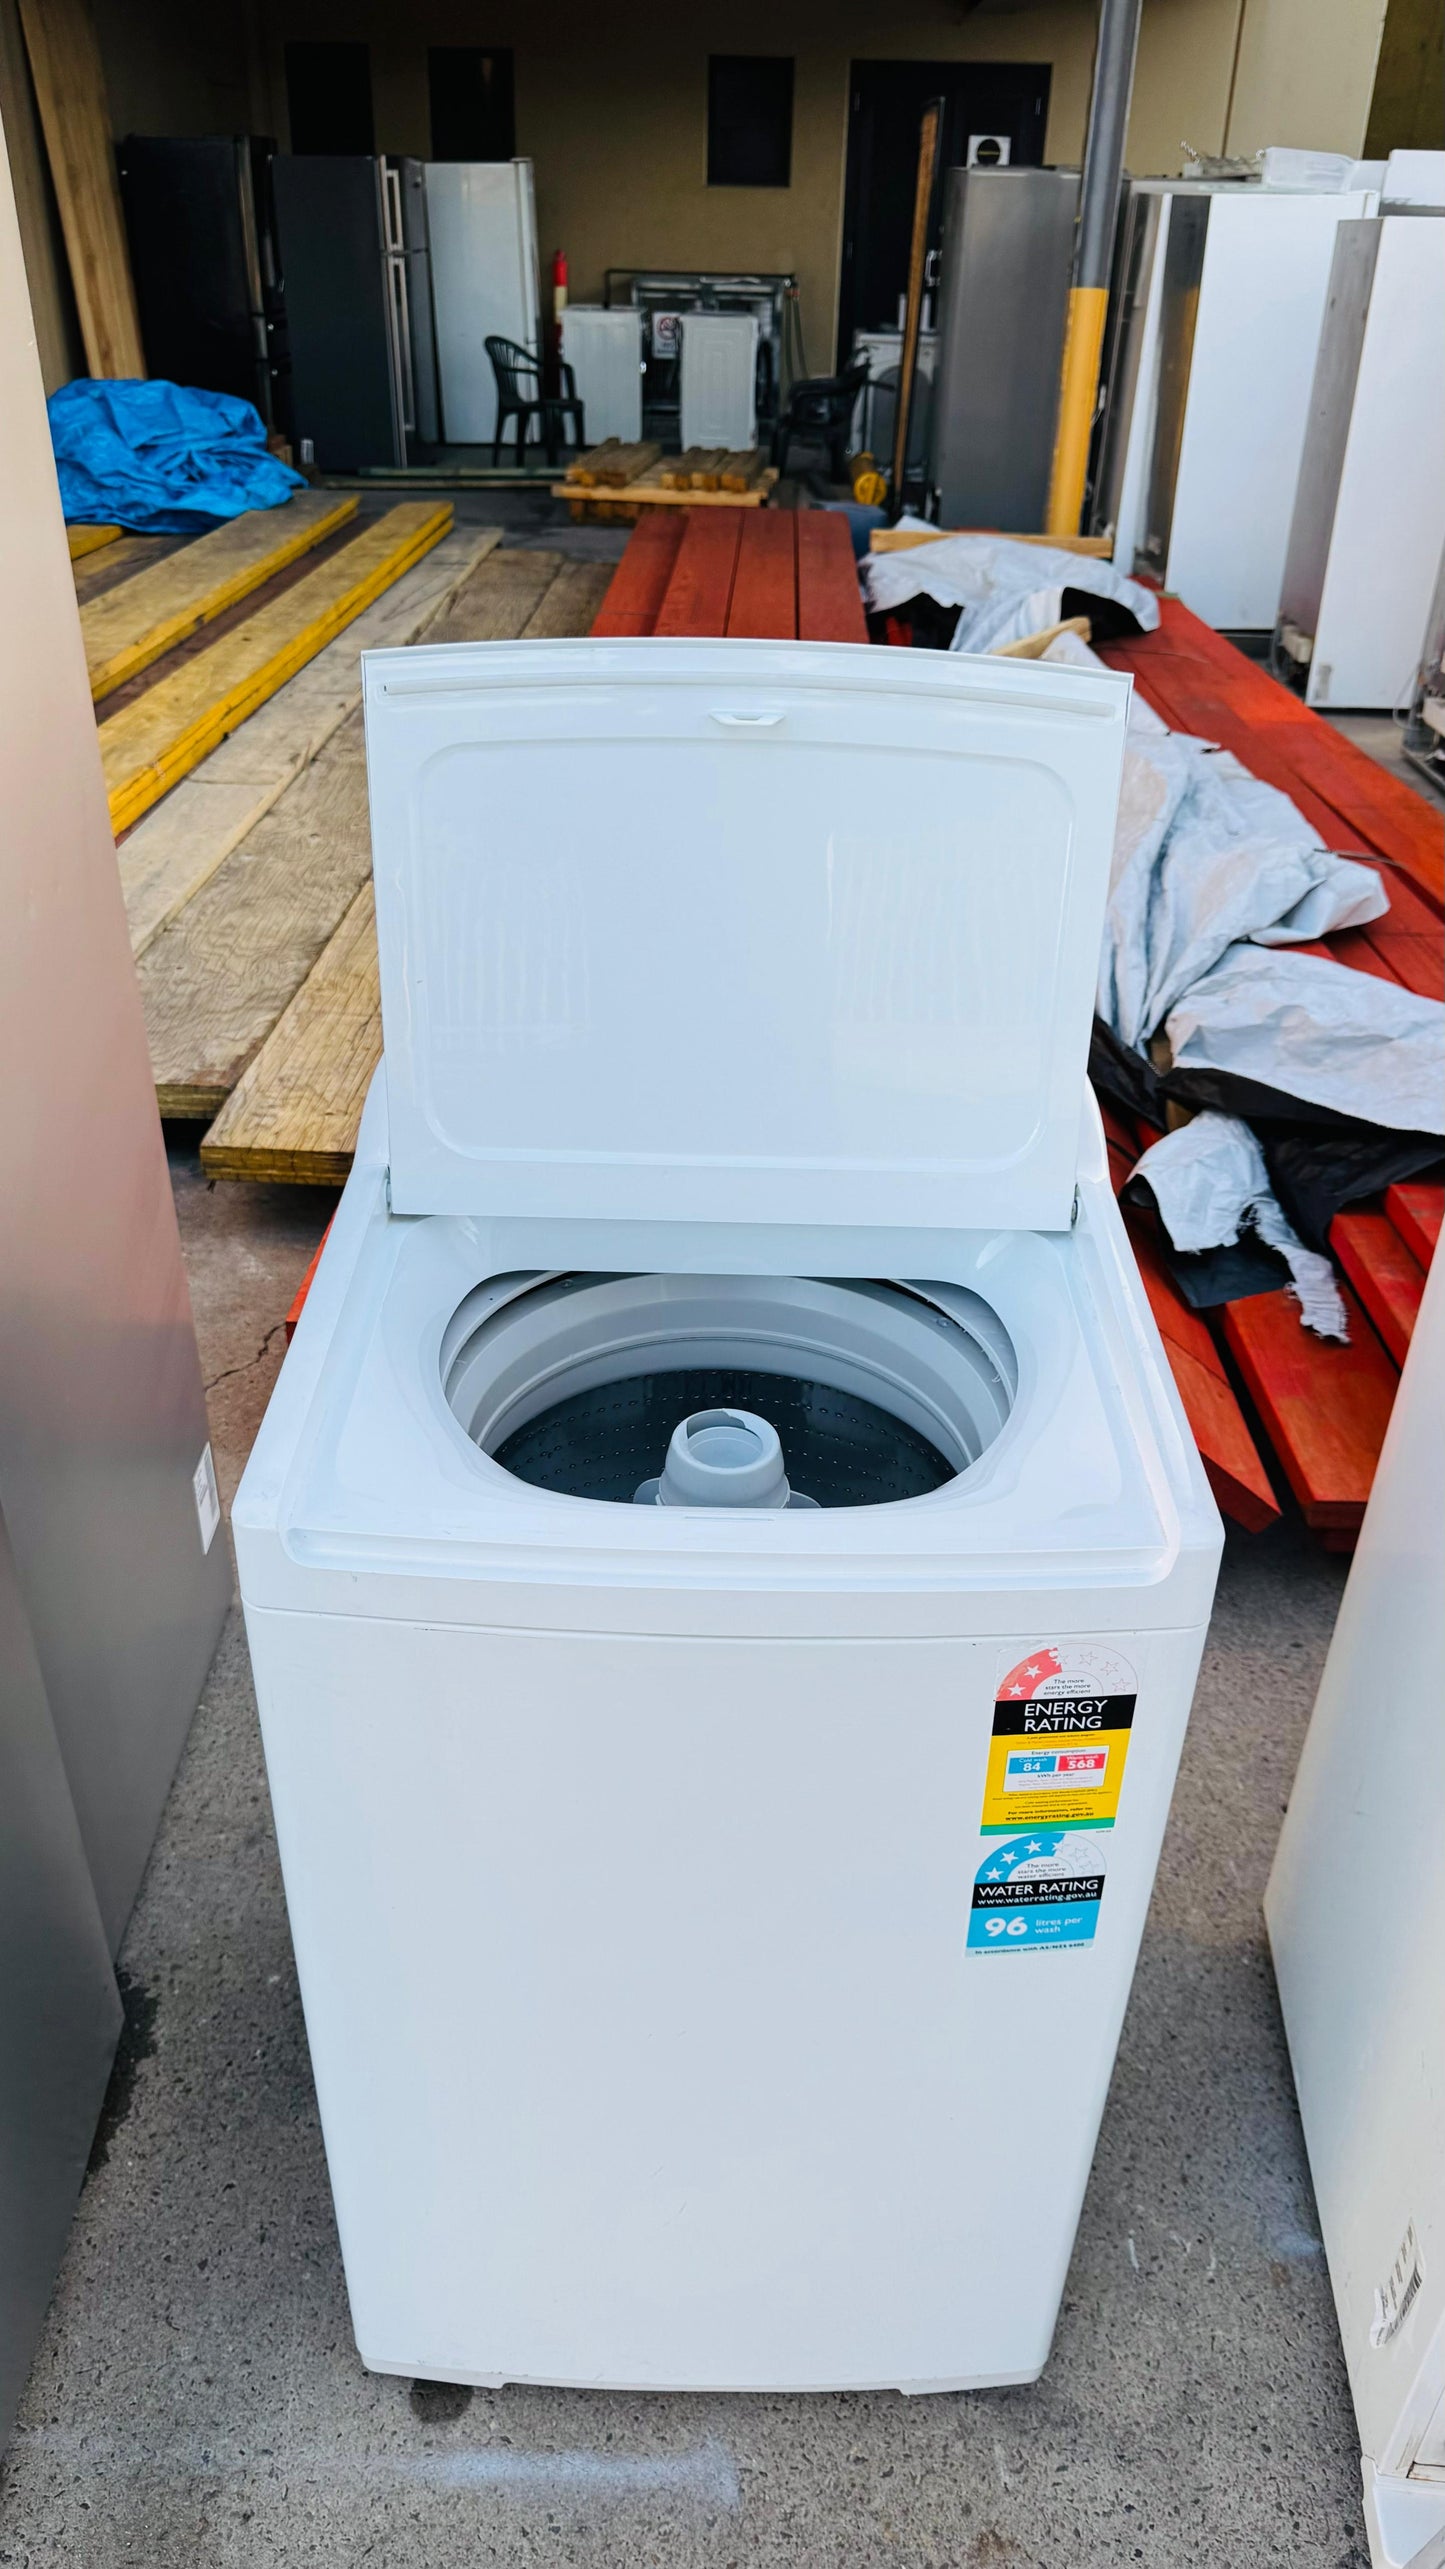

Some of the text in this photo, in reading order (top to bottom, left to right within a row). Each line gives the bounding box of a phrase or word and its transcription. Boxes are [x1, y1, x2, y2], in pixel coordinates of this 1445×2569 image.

[1024, 1700, 1108, 1717] ENERGY
[1024, 1716, 1103, 1732] RATING
[1023, 1762, 1041, 1772] 84
[1068, 1759, 1096, 1770] 568
[1005, 1812, 1094, 1821] www.energyrating.gov.au
[978, 1879, 1099, 1897] WATER RATING
[977, 1891, 1097, 1906] www.waterrating.gov.au
[984, 1916, 1028, 1937] 96
[1036, 1917, 1083, 1927] litres per
[1035, 1925, 1061, 1934] wash
